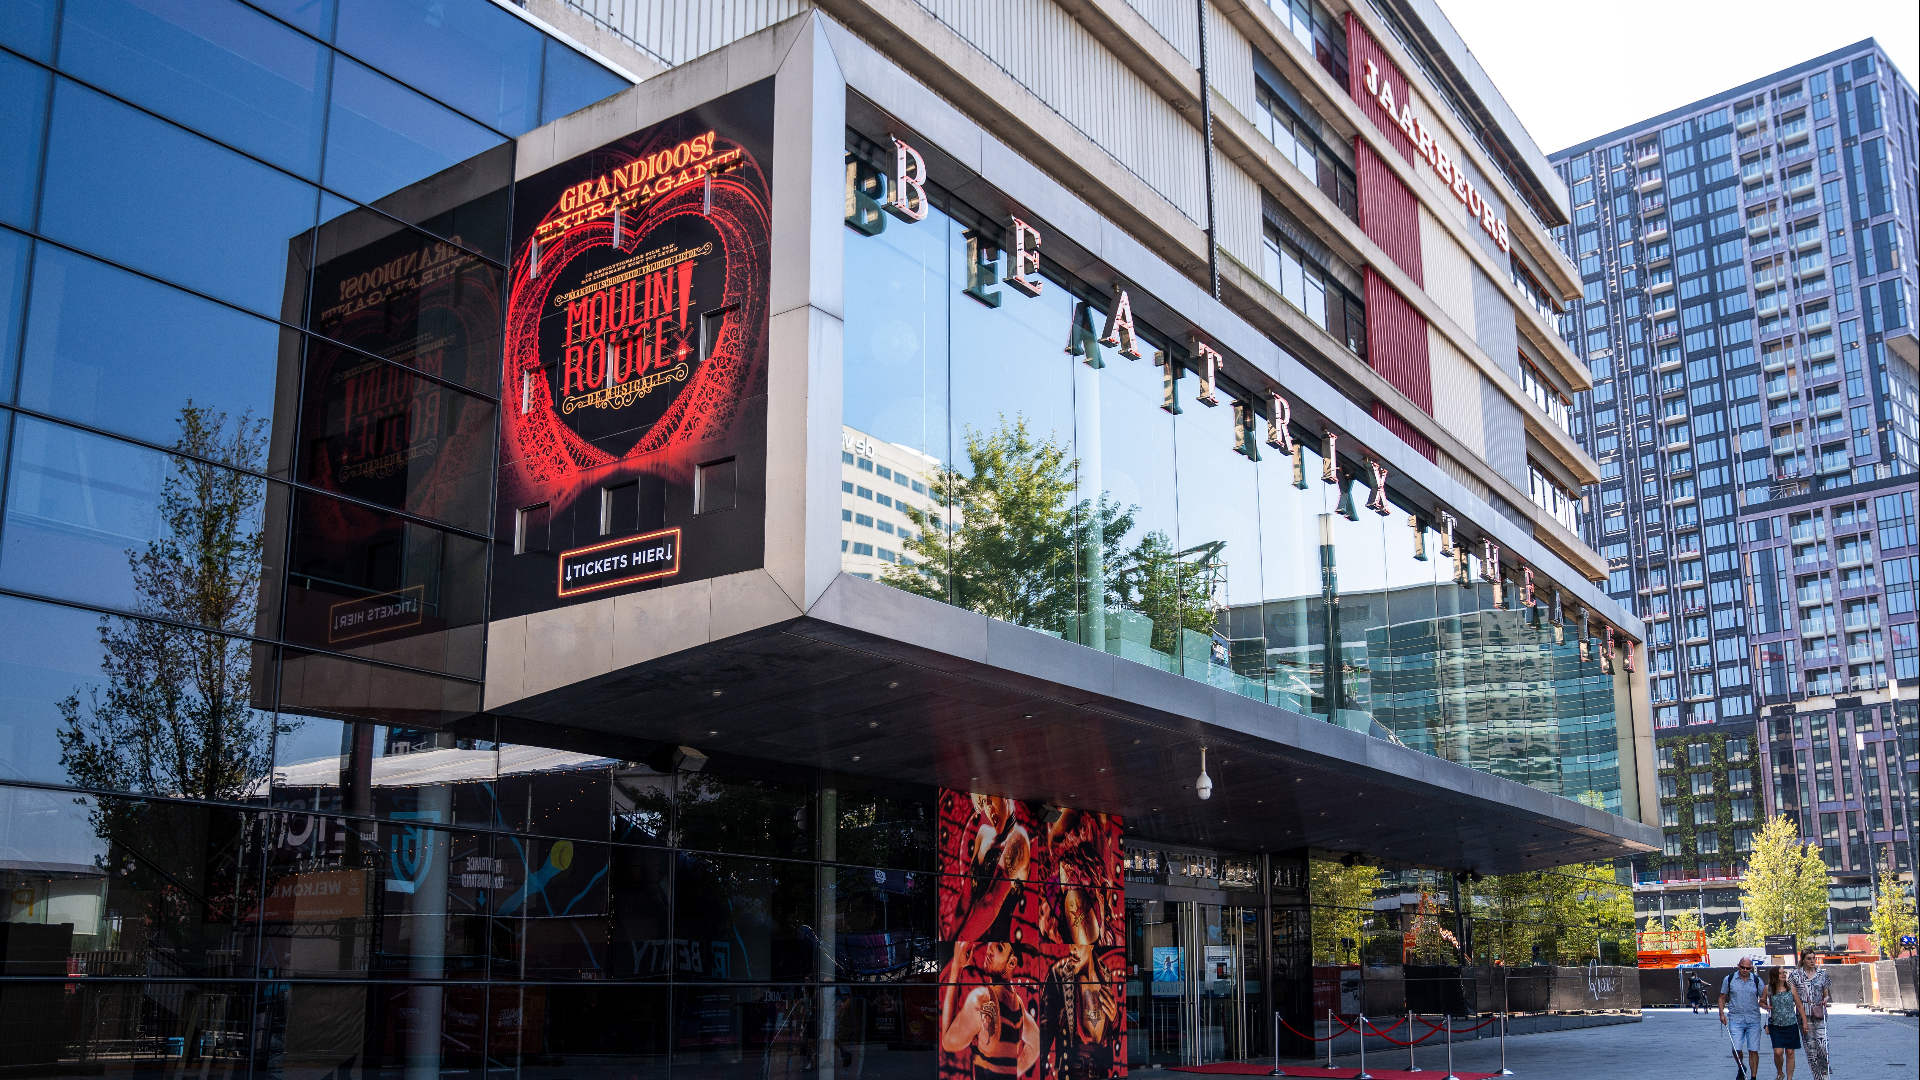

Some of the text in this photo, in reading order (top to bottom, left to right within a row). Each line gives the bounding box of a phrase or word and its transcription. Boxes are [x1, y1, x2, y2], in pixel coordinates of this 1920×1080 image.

[537, 148, 745, 245] EXTRAVAGANT!
[560, 131, 716, 213] GRANDIOOS!
[1363, 58, 1510, 253] JAARBEURS
[882, 136, 1636, 673] BEATRIX THEATER
[573, 547, 665, 579] TICKETS HIER
